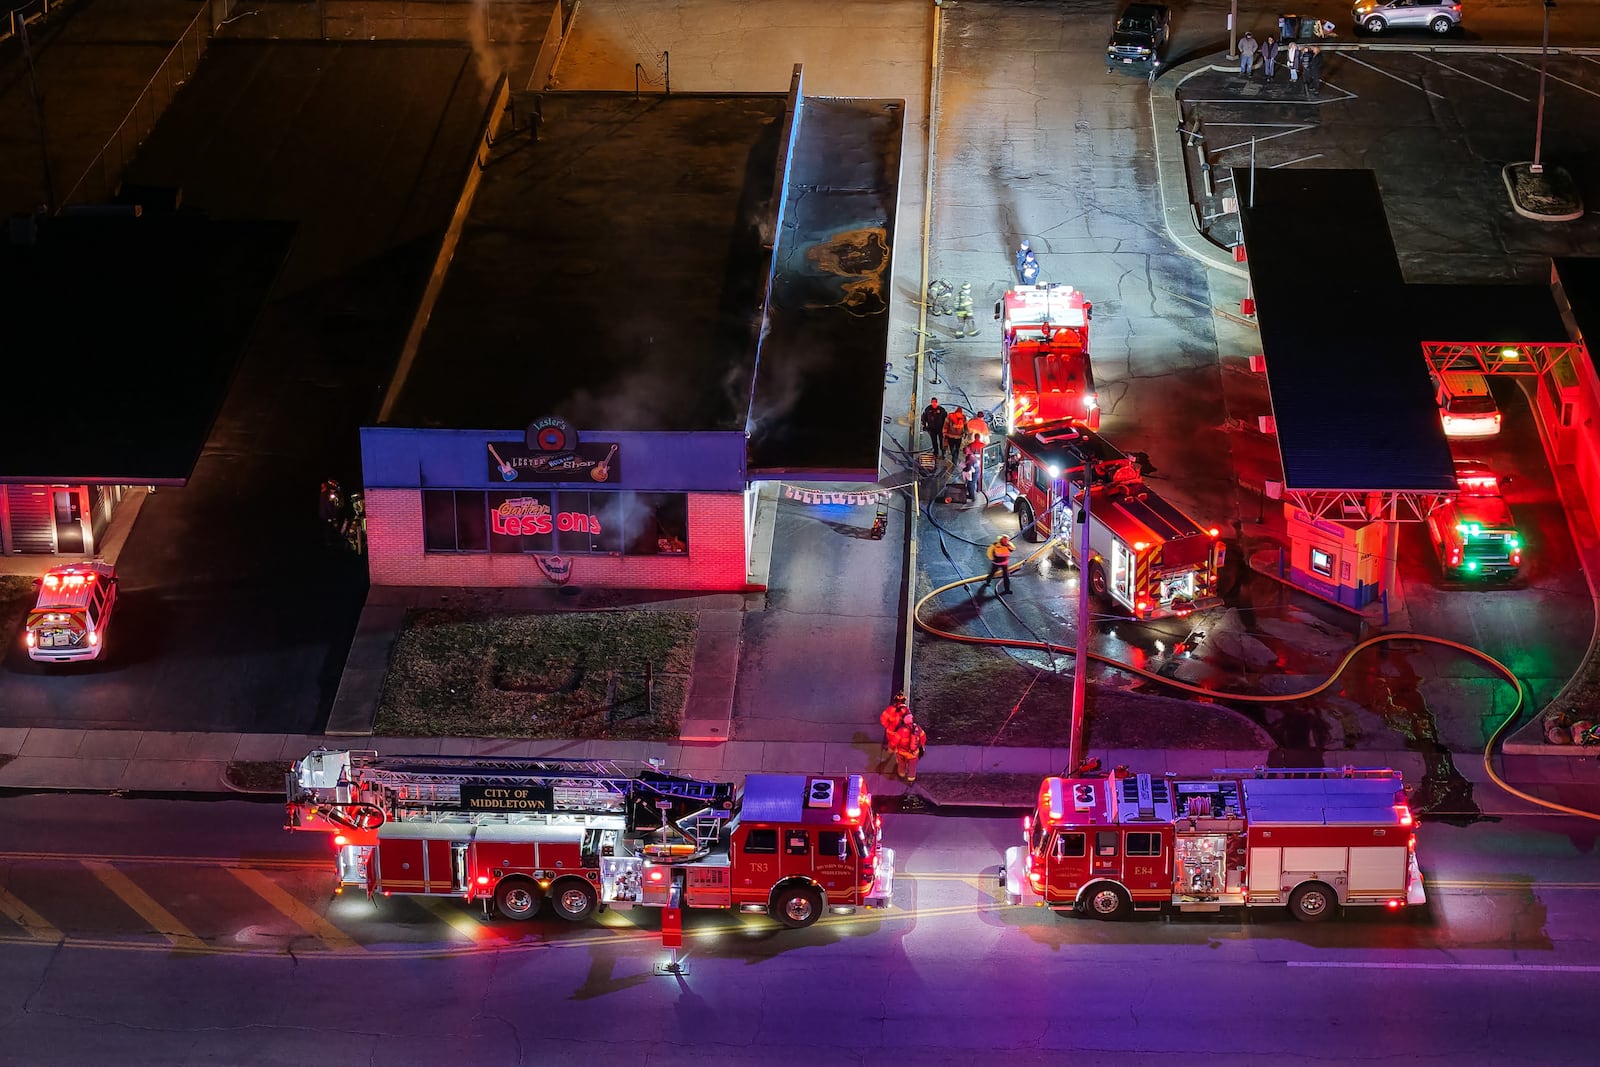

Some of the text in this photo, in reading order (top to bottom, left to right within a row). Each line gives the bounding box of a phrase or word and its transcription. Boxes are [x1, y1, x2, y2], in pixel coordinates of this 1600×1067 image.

[533, 418, 567, 430] Lester's
[491, 509, 602, 535] Lessons
[484, 788, 528, 798] CITY OF
[470, 798, 545, 808] MIDDLETOWN
[749, 863, 768, 872] T83
[1134, 866, 1152, 875] E84
